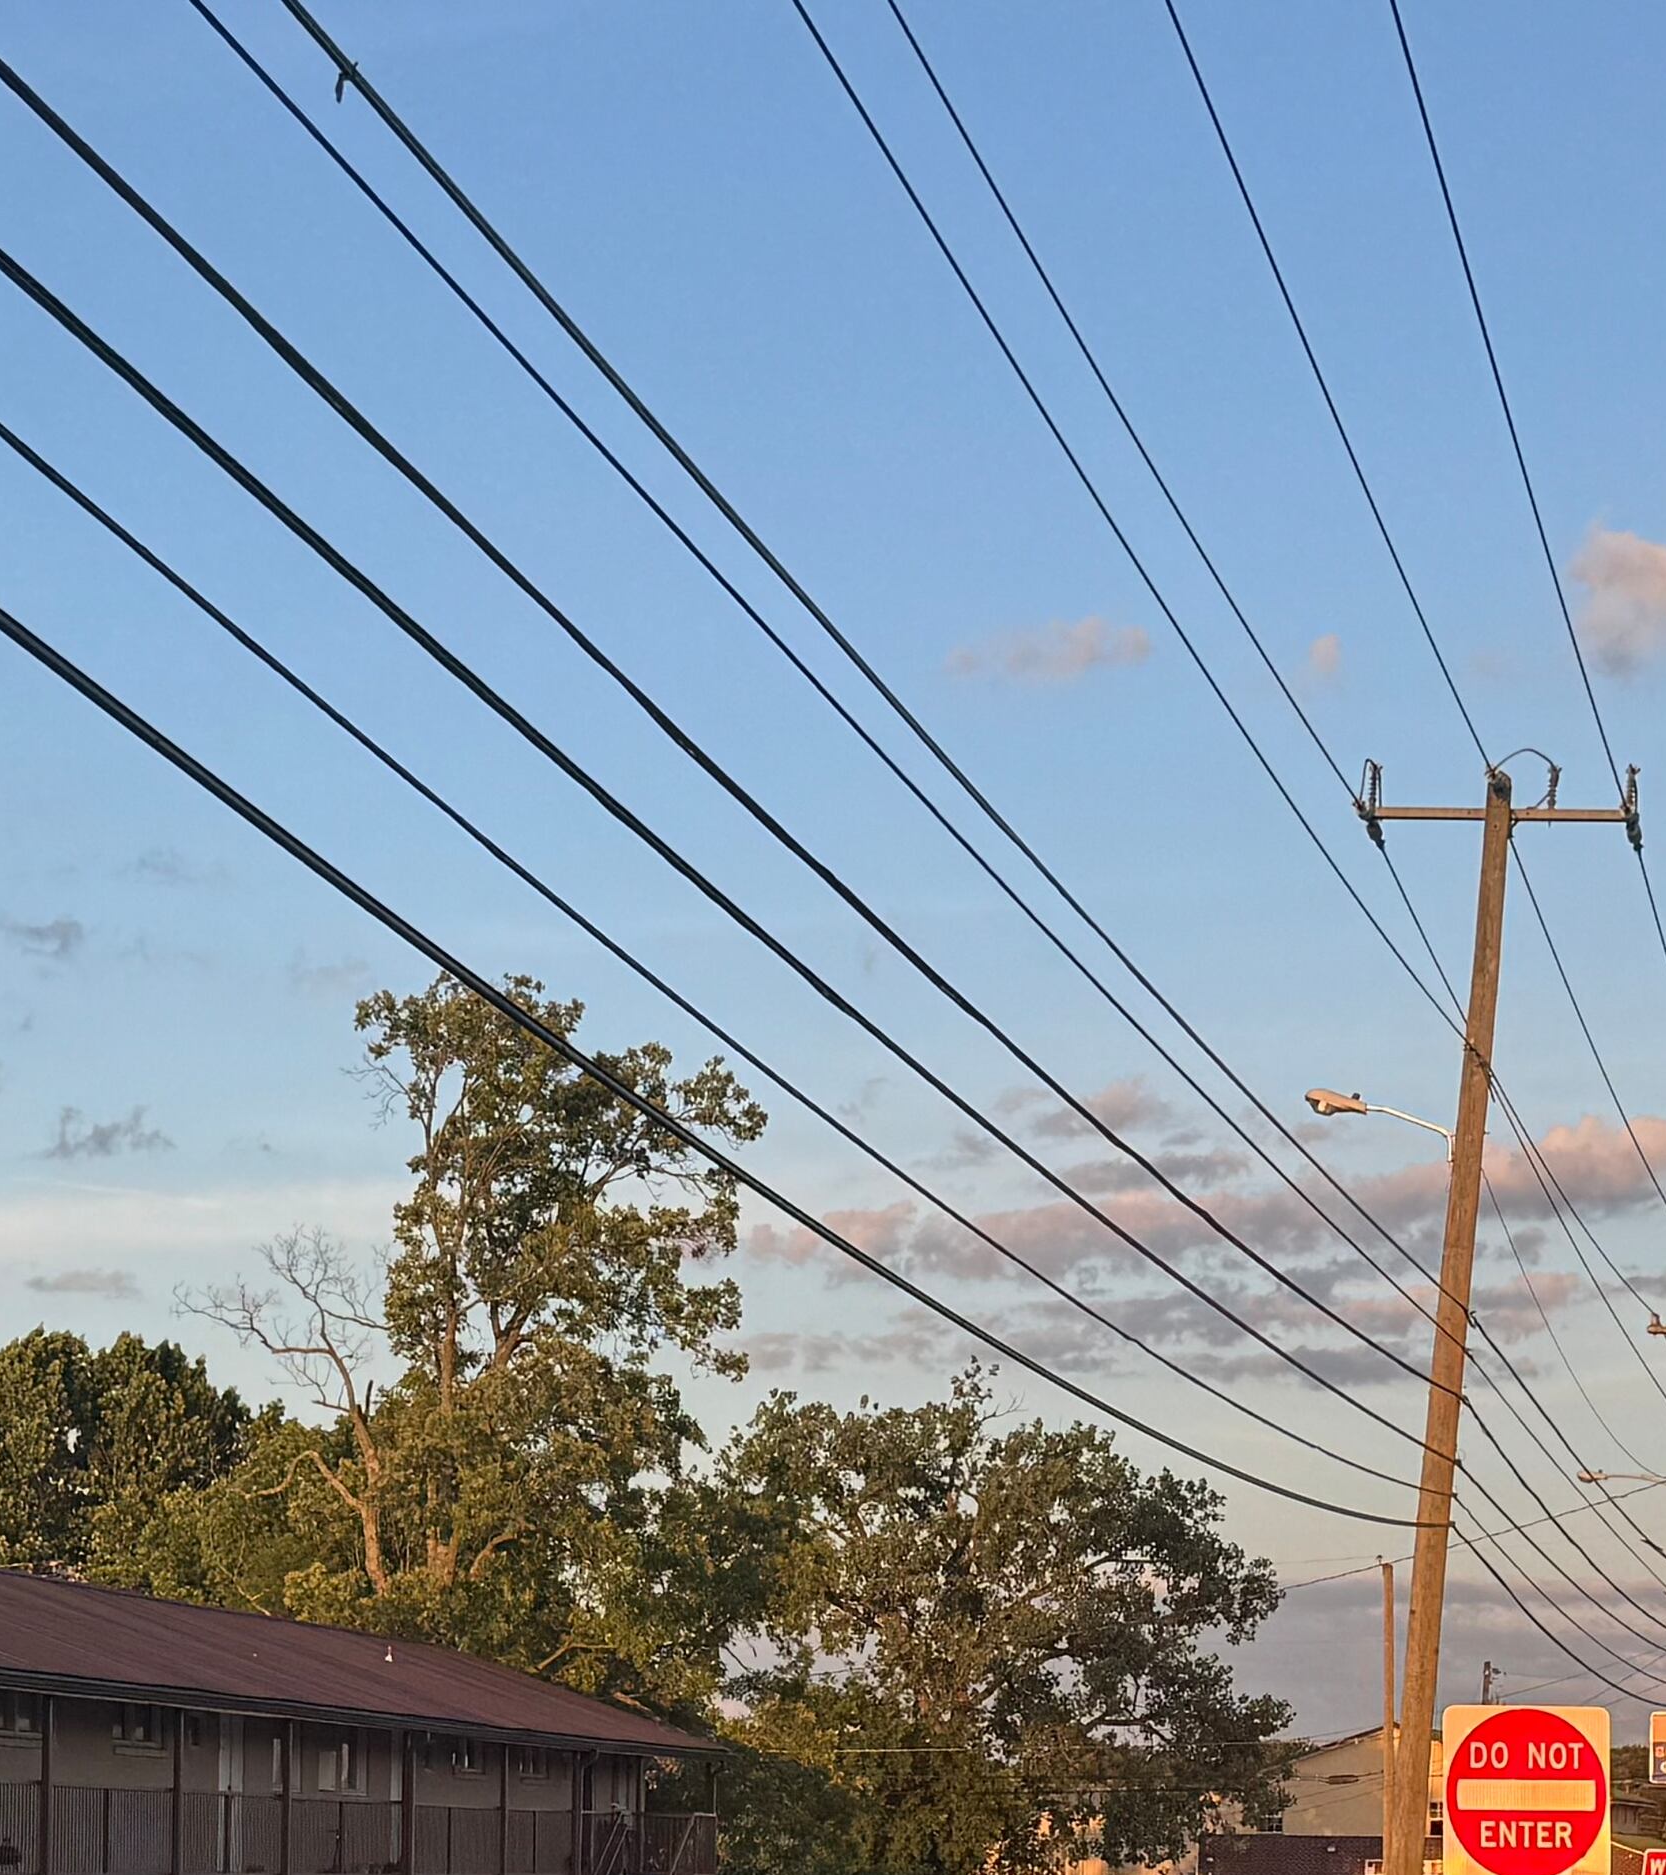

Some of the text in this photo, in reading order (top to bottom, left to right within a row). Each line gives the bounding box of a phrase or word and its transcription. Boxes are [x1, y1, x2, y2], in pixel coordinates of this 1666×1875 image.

[1469, 1741, 1584, 1770] DO NOT
[1480, 1820, 1573, 1849] ENTER
